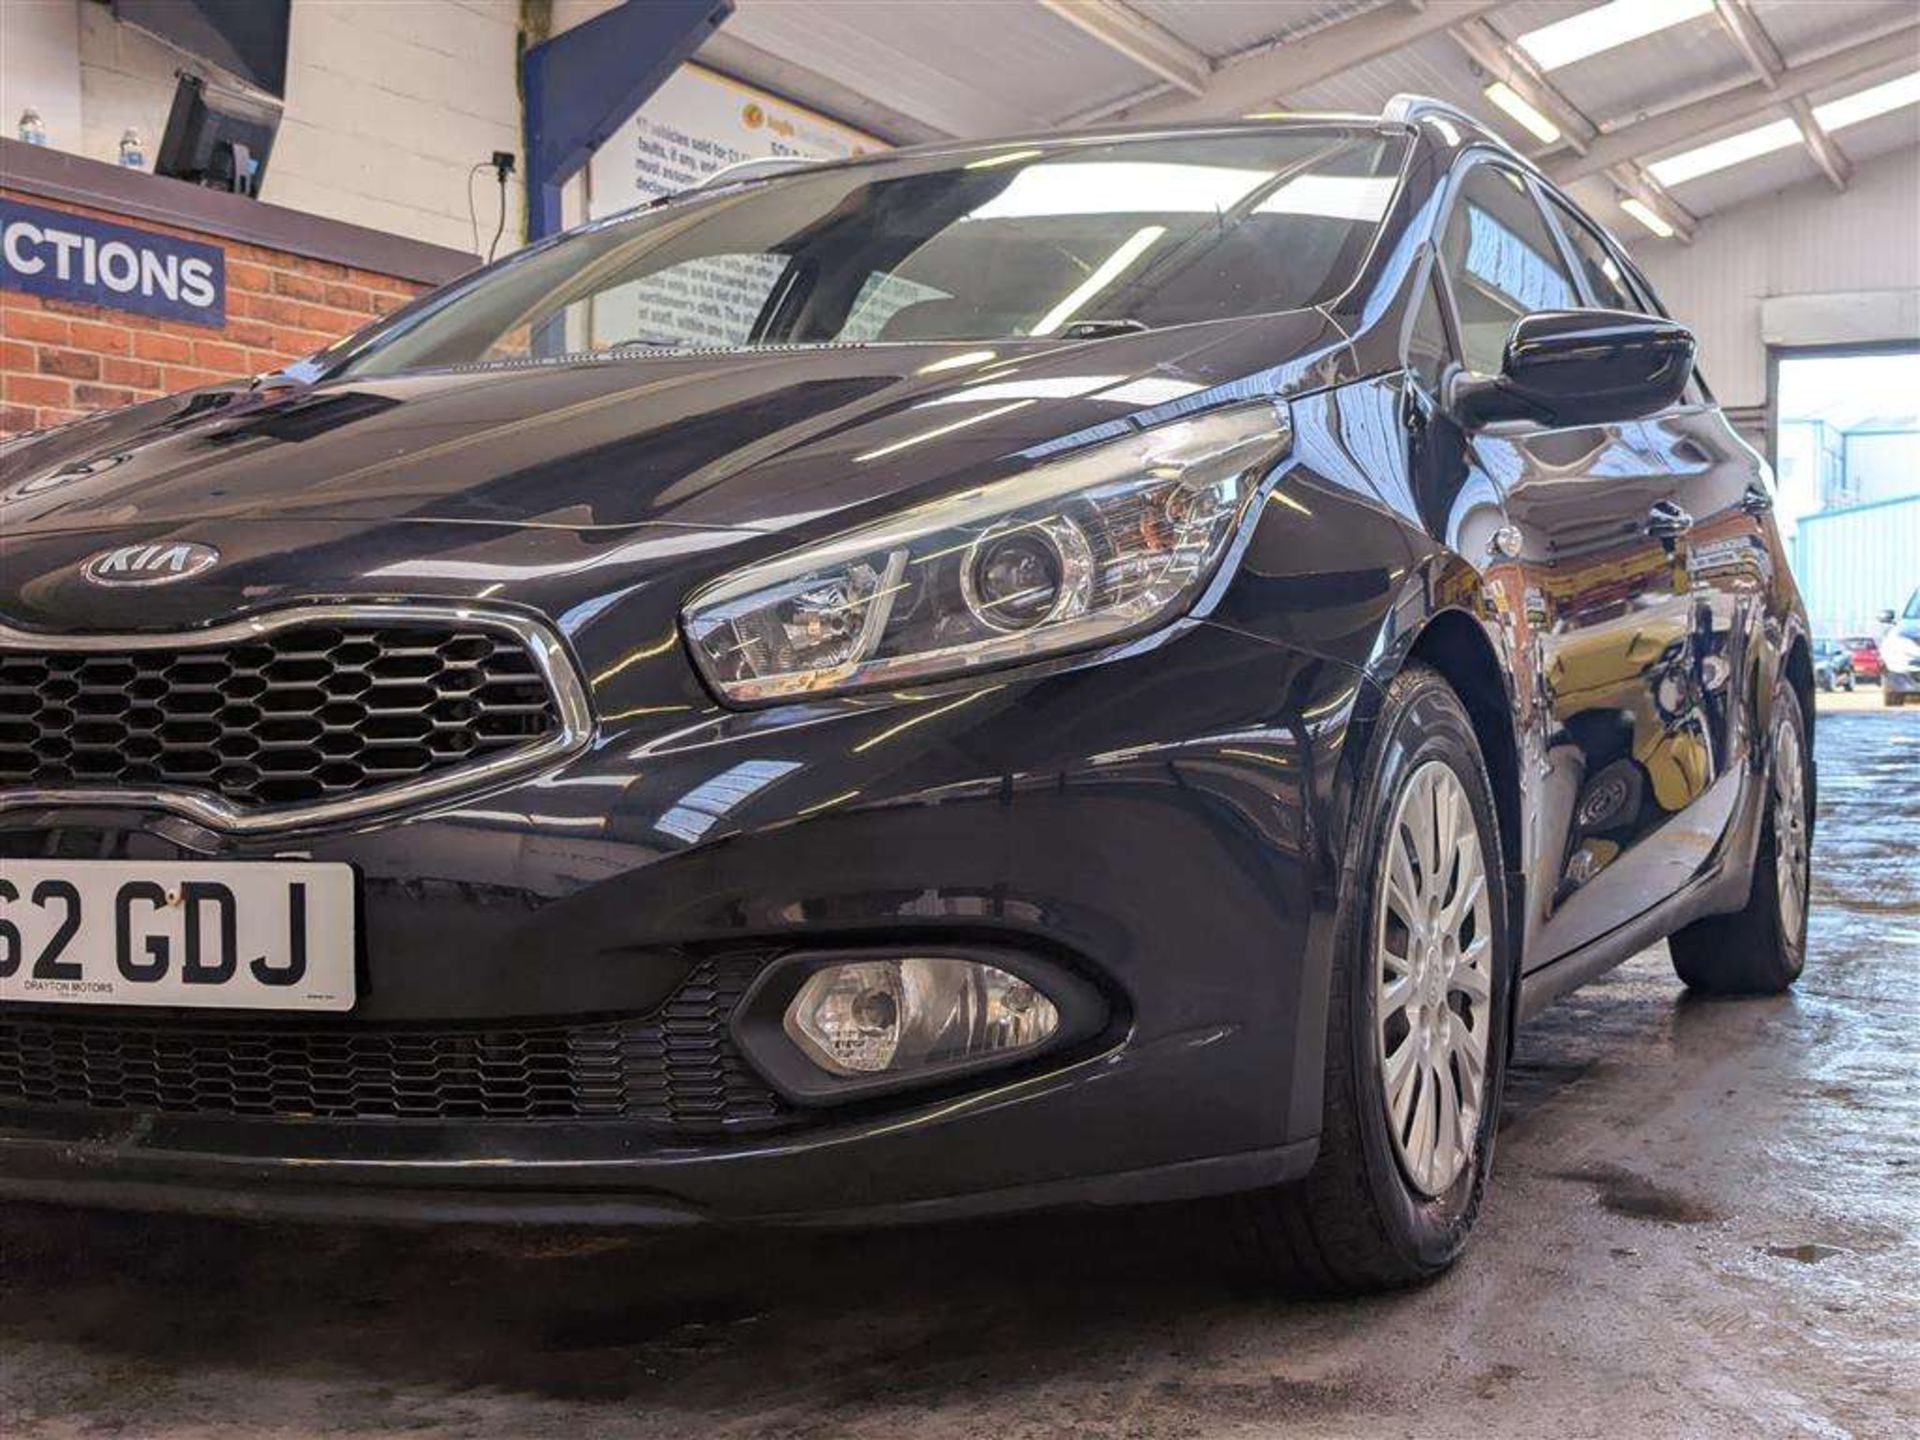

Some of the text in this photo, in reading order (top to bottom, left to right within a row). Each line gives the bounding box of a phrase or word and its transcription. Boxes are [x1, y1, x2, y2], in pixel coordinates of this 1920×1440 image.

[4, 222, 215, 307] CTIONS
[99, 545, 190, 573] KIA
[115, 880, 307, 986] GDJ
[71, 982, 113, 994] MOTORS
